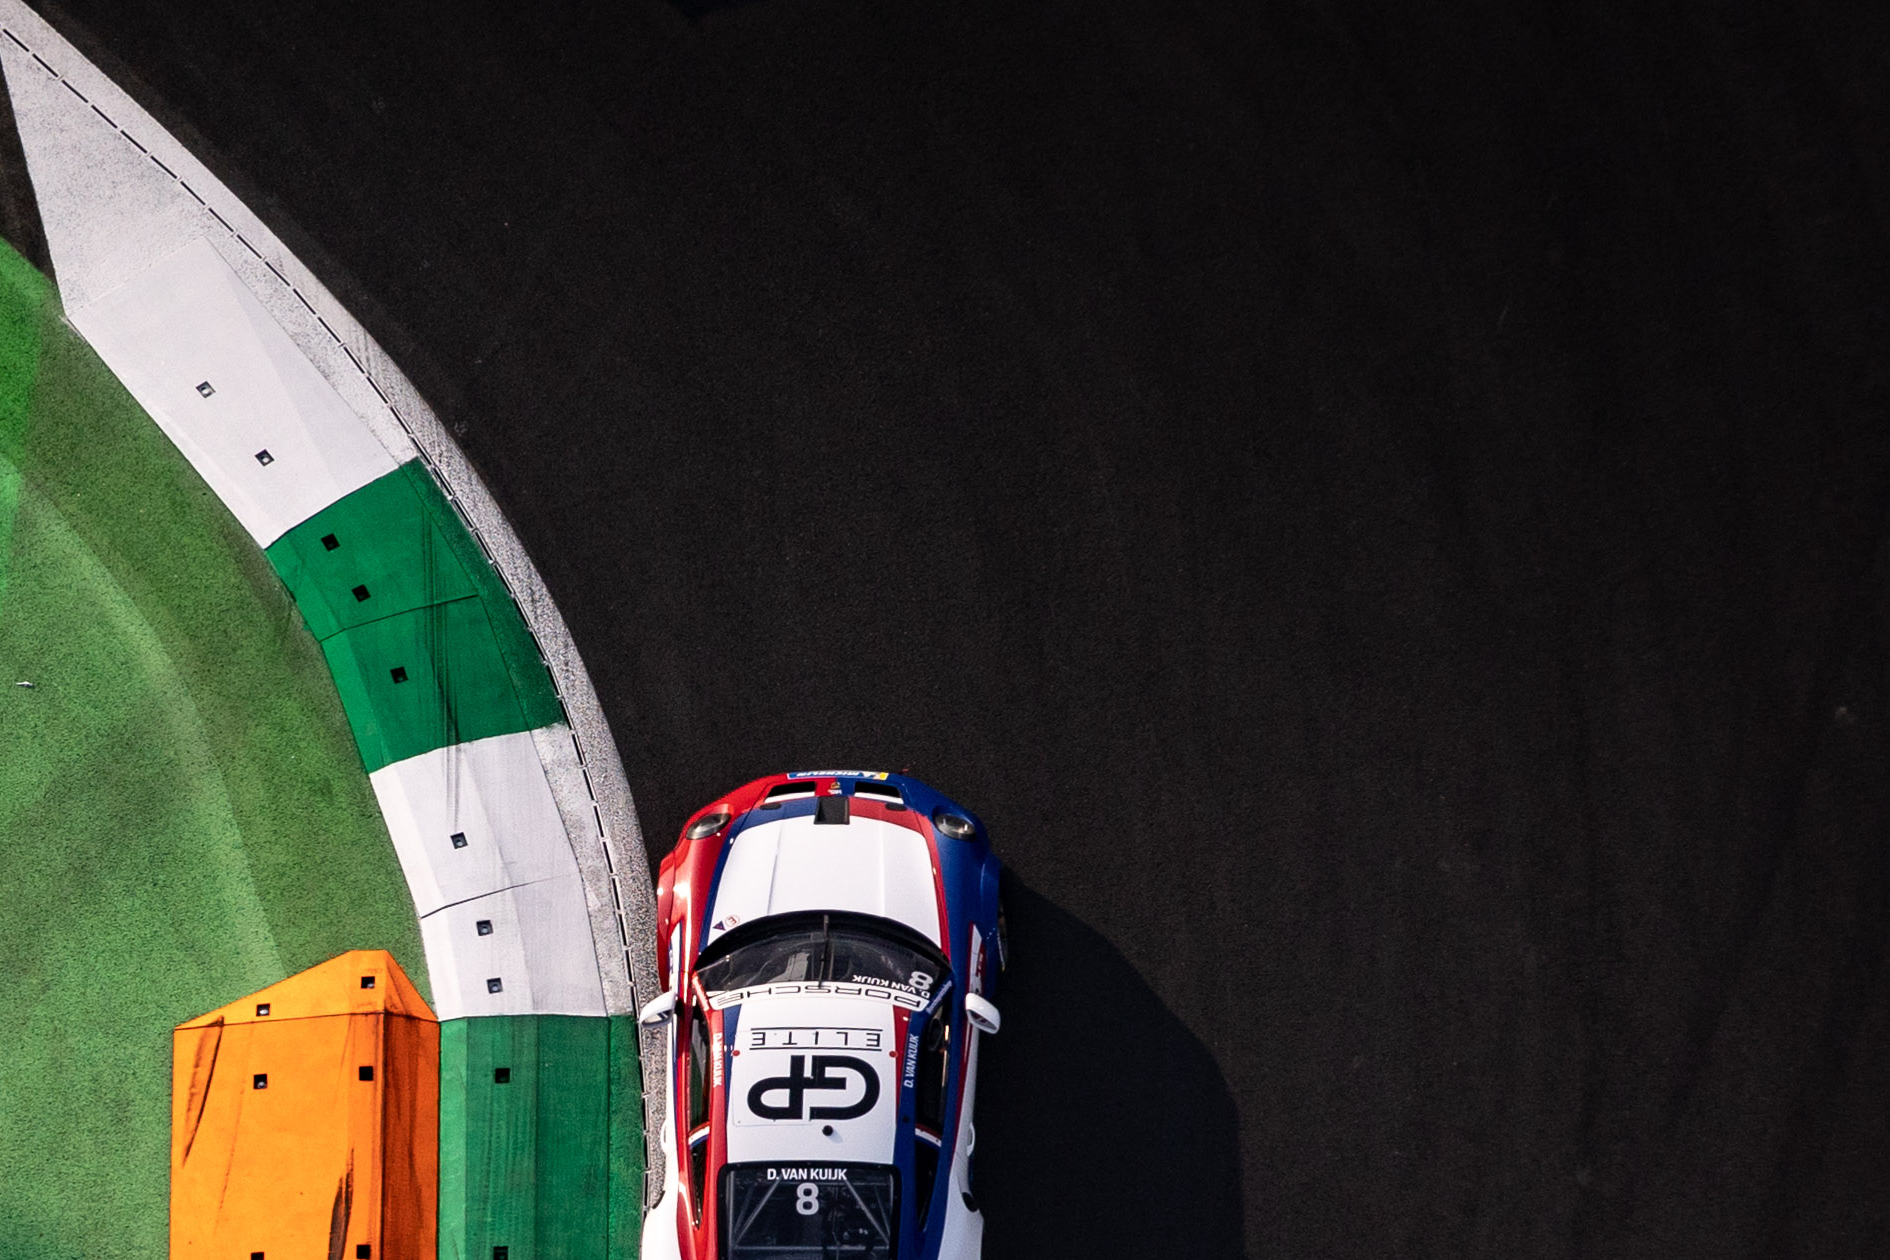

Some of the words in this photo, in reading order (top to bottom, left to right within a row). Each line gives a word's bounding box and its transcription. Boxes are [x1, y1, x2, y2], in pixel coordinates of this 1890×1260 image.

[852, 974, 889, 987] KUIJK
[891, 981, 916, 994] VAN
[909, 971, 933, 990] 8
[717, 985, 921, 1008] PORSCHE
[920, 989, 930, 999] D.
[752, 1031, 881, 1047] ELITE
[905, 1059, 916, 1077] VAN
[747, 1054, 880, 1120] GP
[904, 1079, 914, 1088] D.
[767, 1168, 780, 1180] D.
[781, 1168, 808, 1180] VAN
[810, 1168, 847, 1180] KUIJK
[796, 1182, 819, 1215] 8
